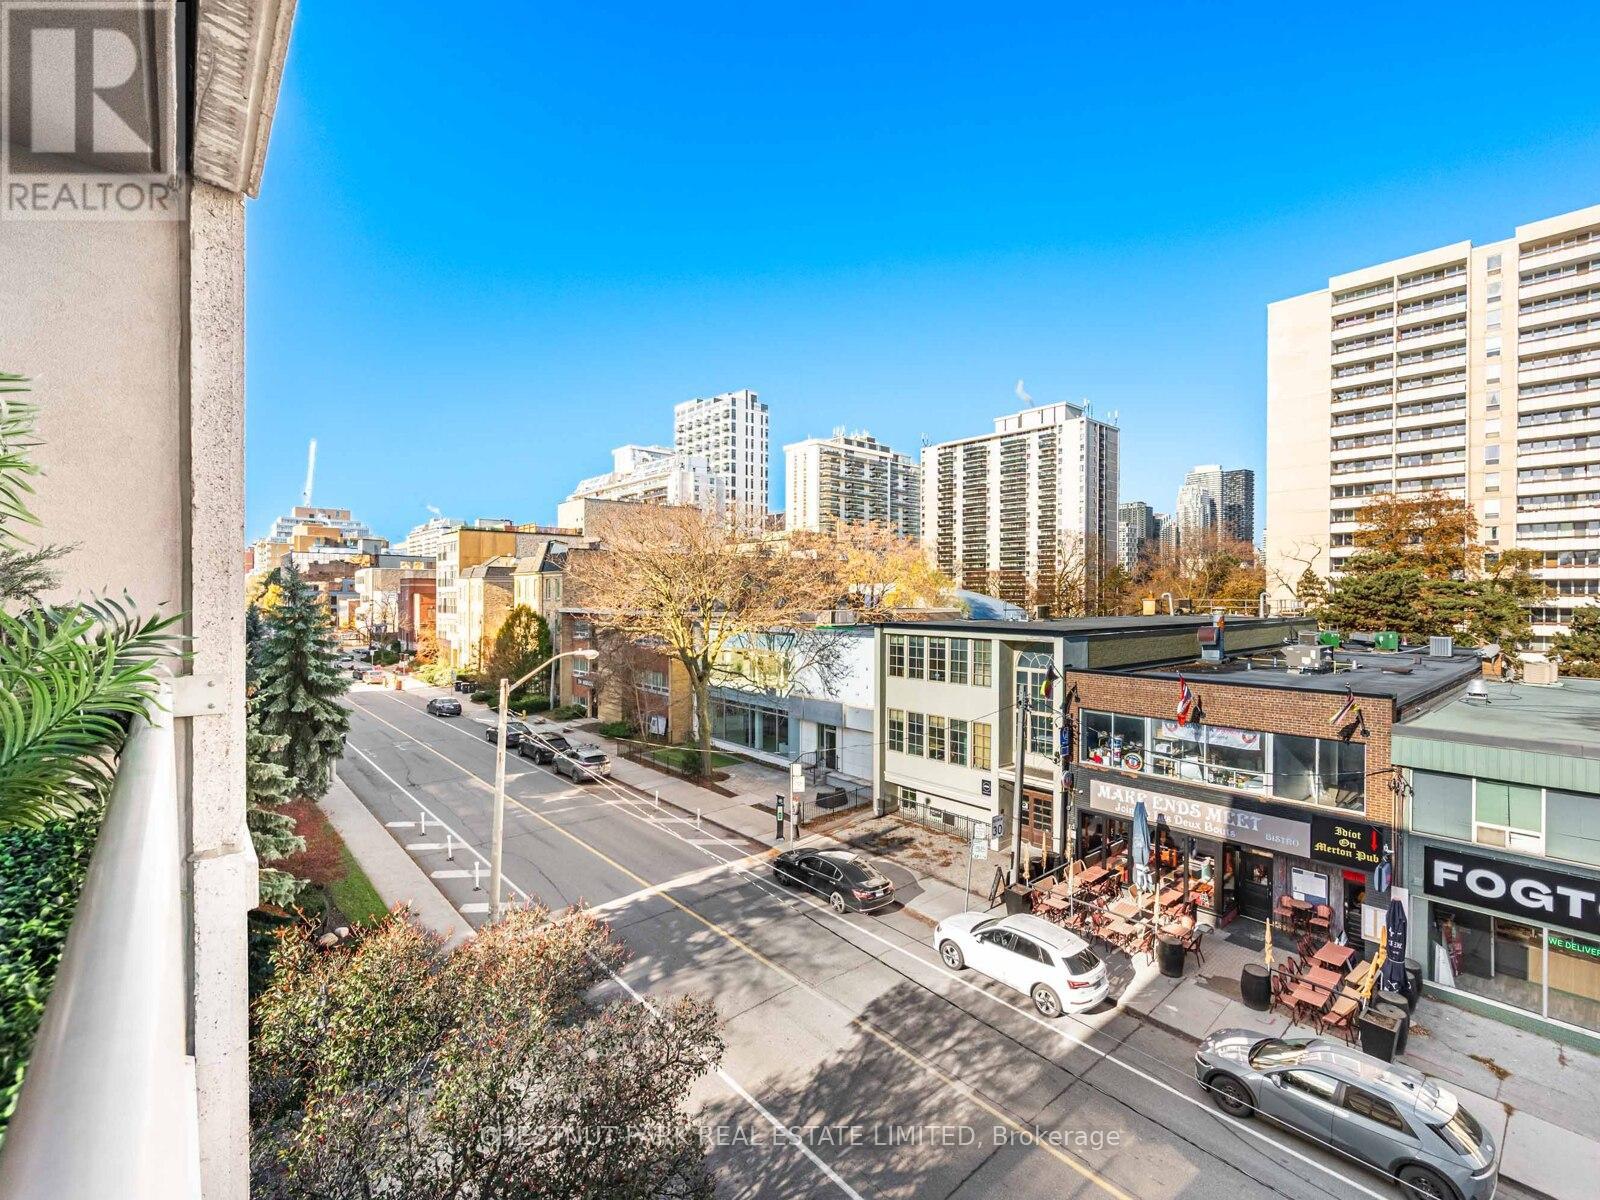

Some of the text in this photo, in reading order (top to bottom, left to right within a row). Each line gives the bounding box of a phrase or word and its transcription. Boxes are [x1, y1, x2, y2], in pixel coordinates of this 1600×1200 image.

[1152, 796, 1202, 818] ENDS
[1205, 807, 1263, 832] MEET
[1174, 814, 1201, 830] Deux
[992, 824, 1003, 836] 30
[1334, 826, 1362, 840] Idiot
[1338, 838, 1357, 850] On
[1314, 842, 1380, 864] Merton Pub
[1433, 858, 1600, 919] FOGT
[1548, 936, 1563, 948] WE
